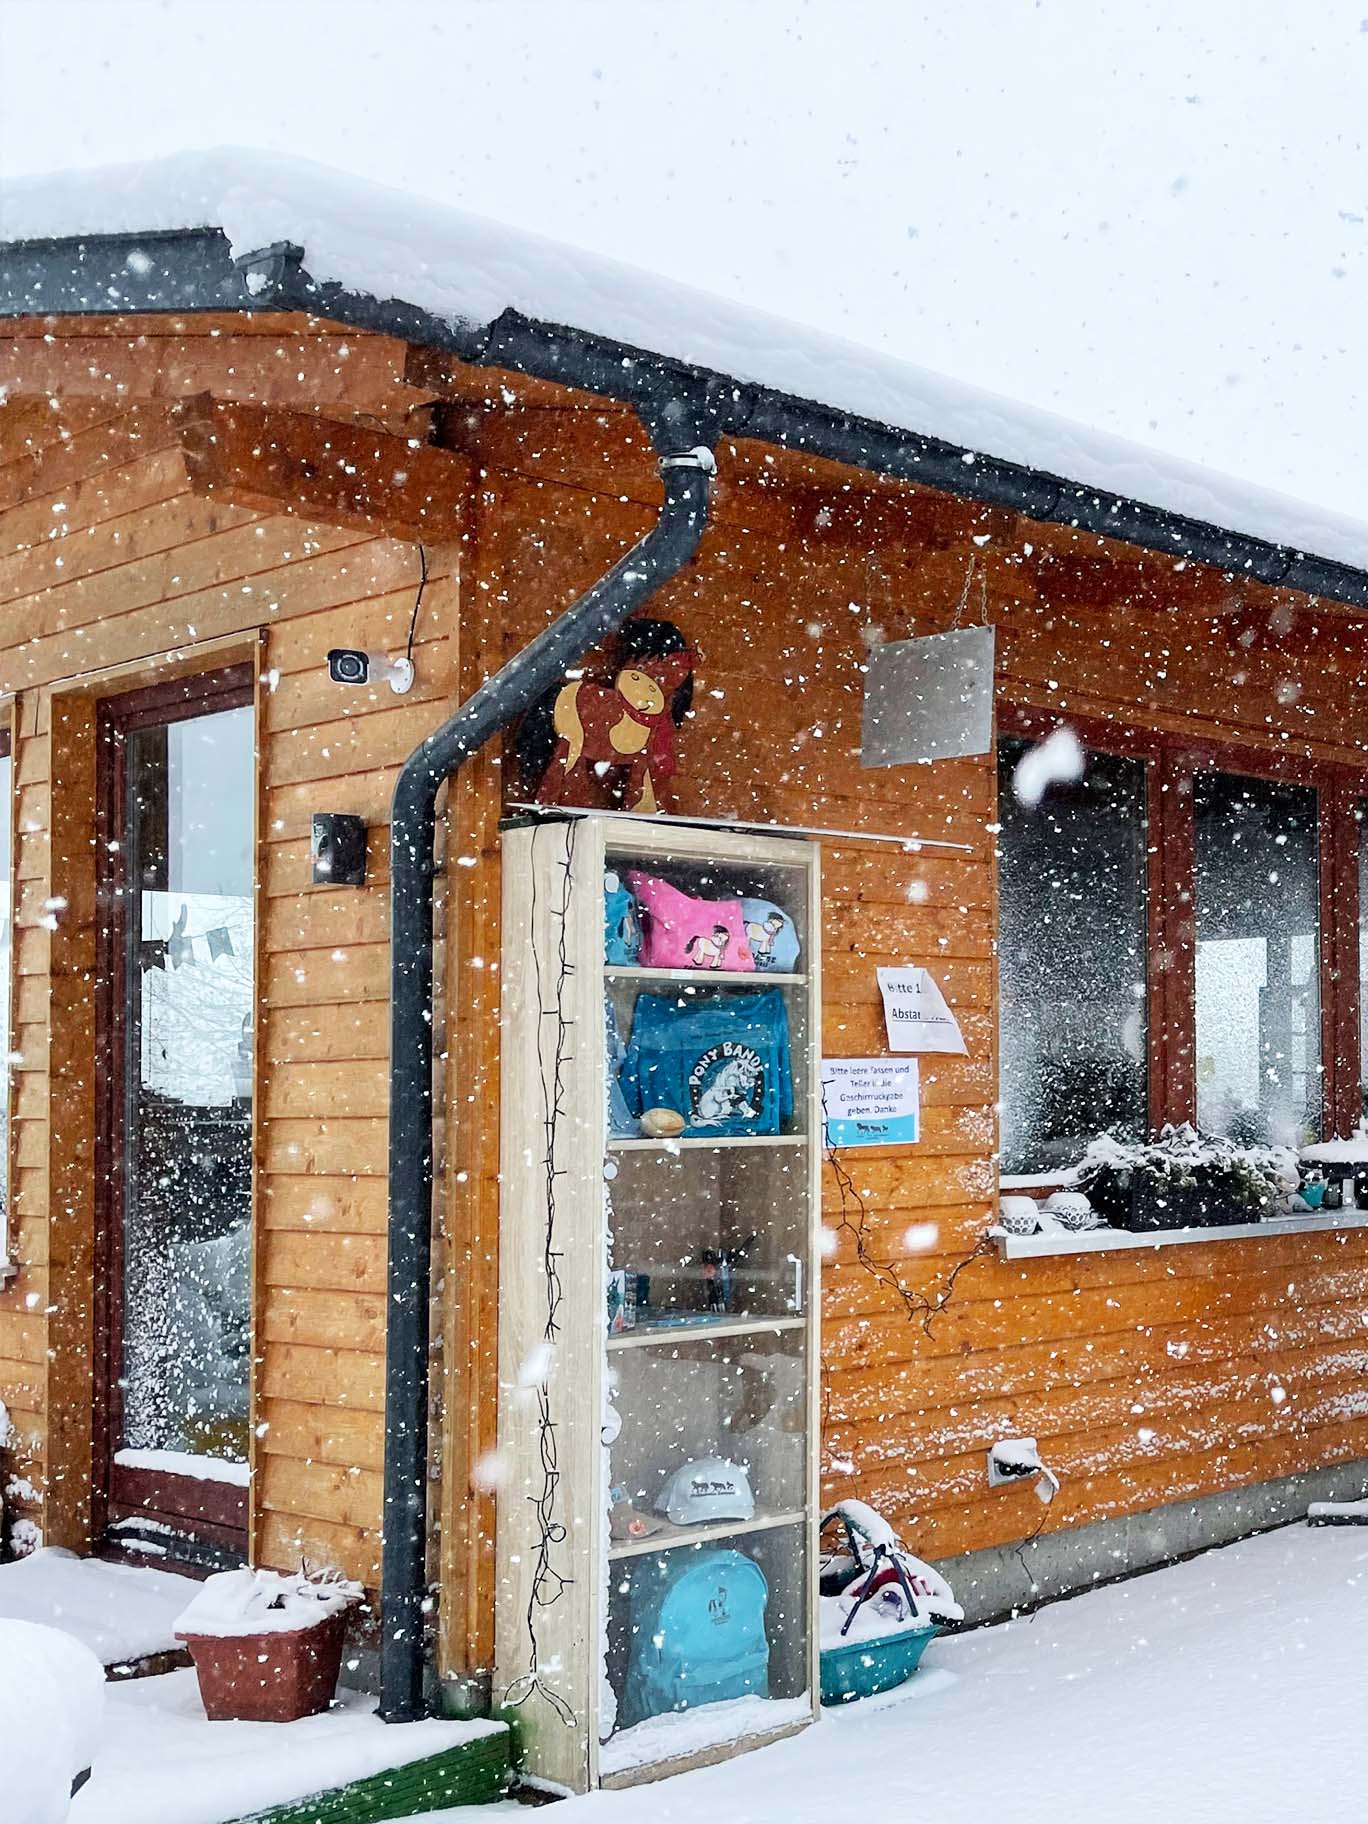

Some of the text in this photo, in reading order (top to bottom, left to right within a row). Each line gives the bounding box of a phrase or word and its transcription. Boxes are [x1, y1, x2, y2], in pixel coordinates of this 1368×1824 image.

[888, 982, 913, 994] Btte
[688, 1048, 718, 1085] PONY
[895, 1065, 910, 1074] und
